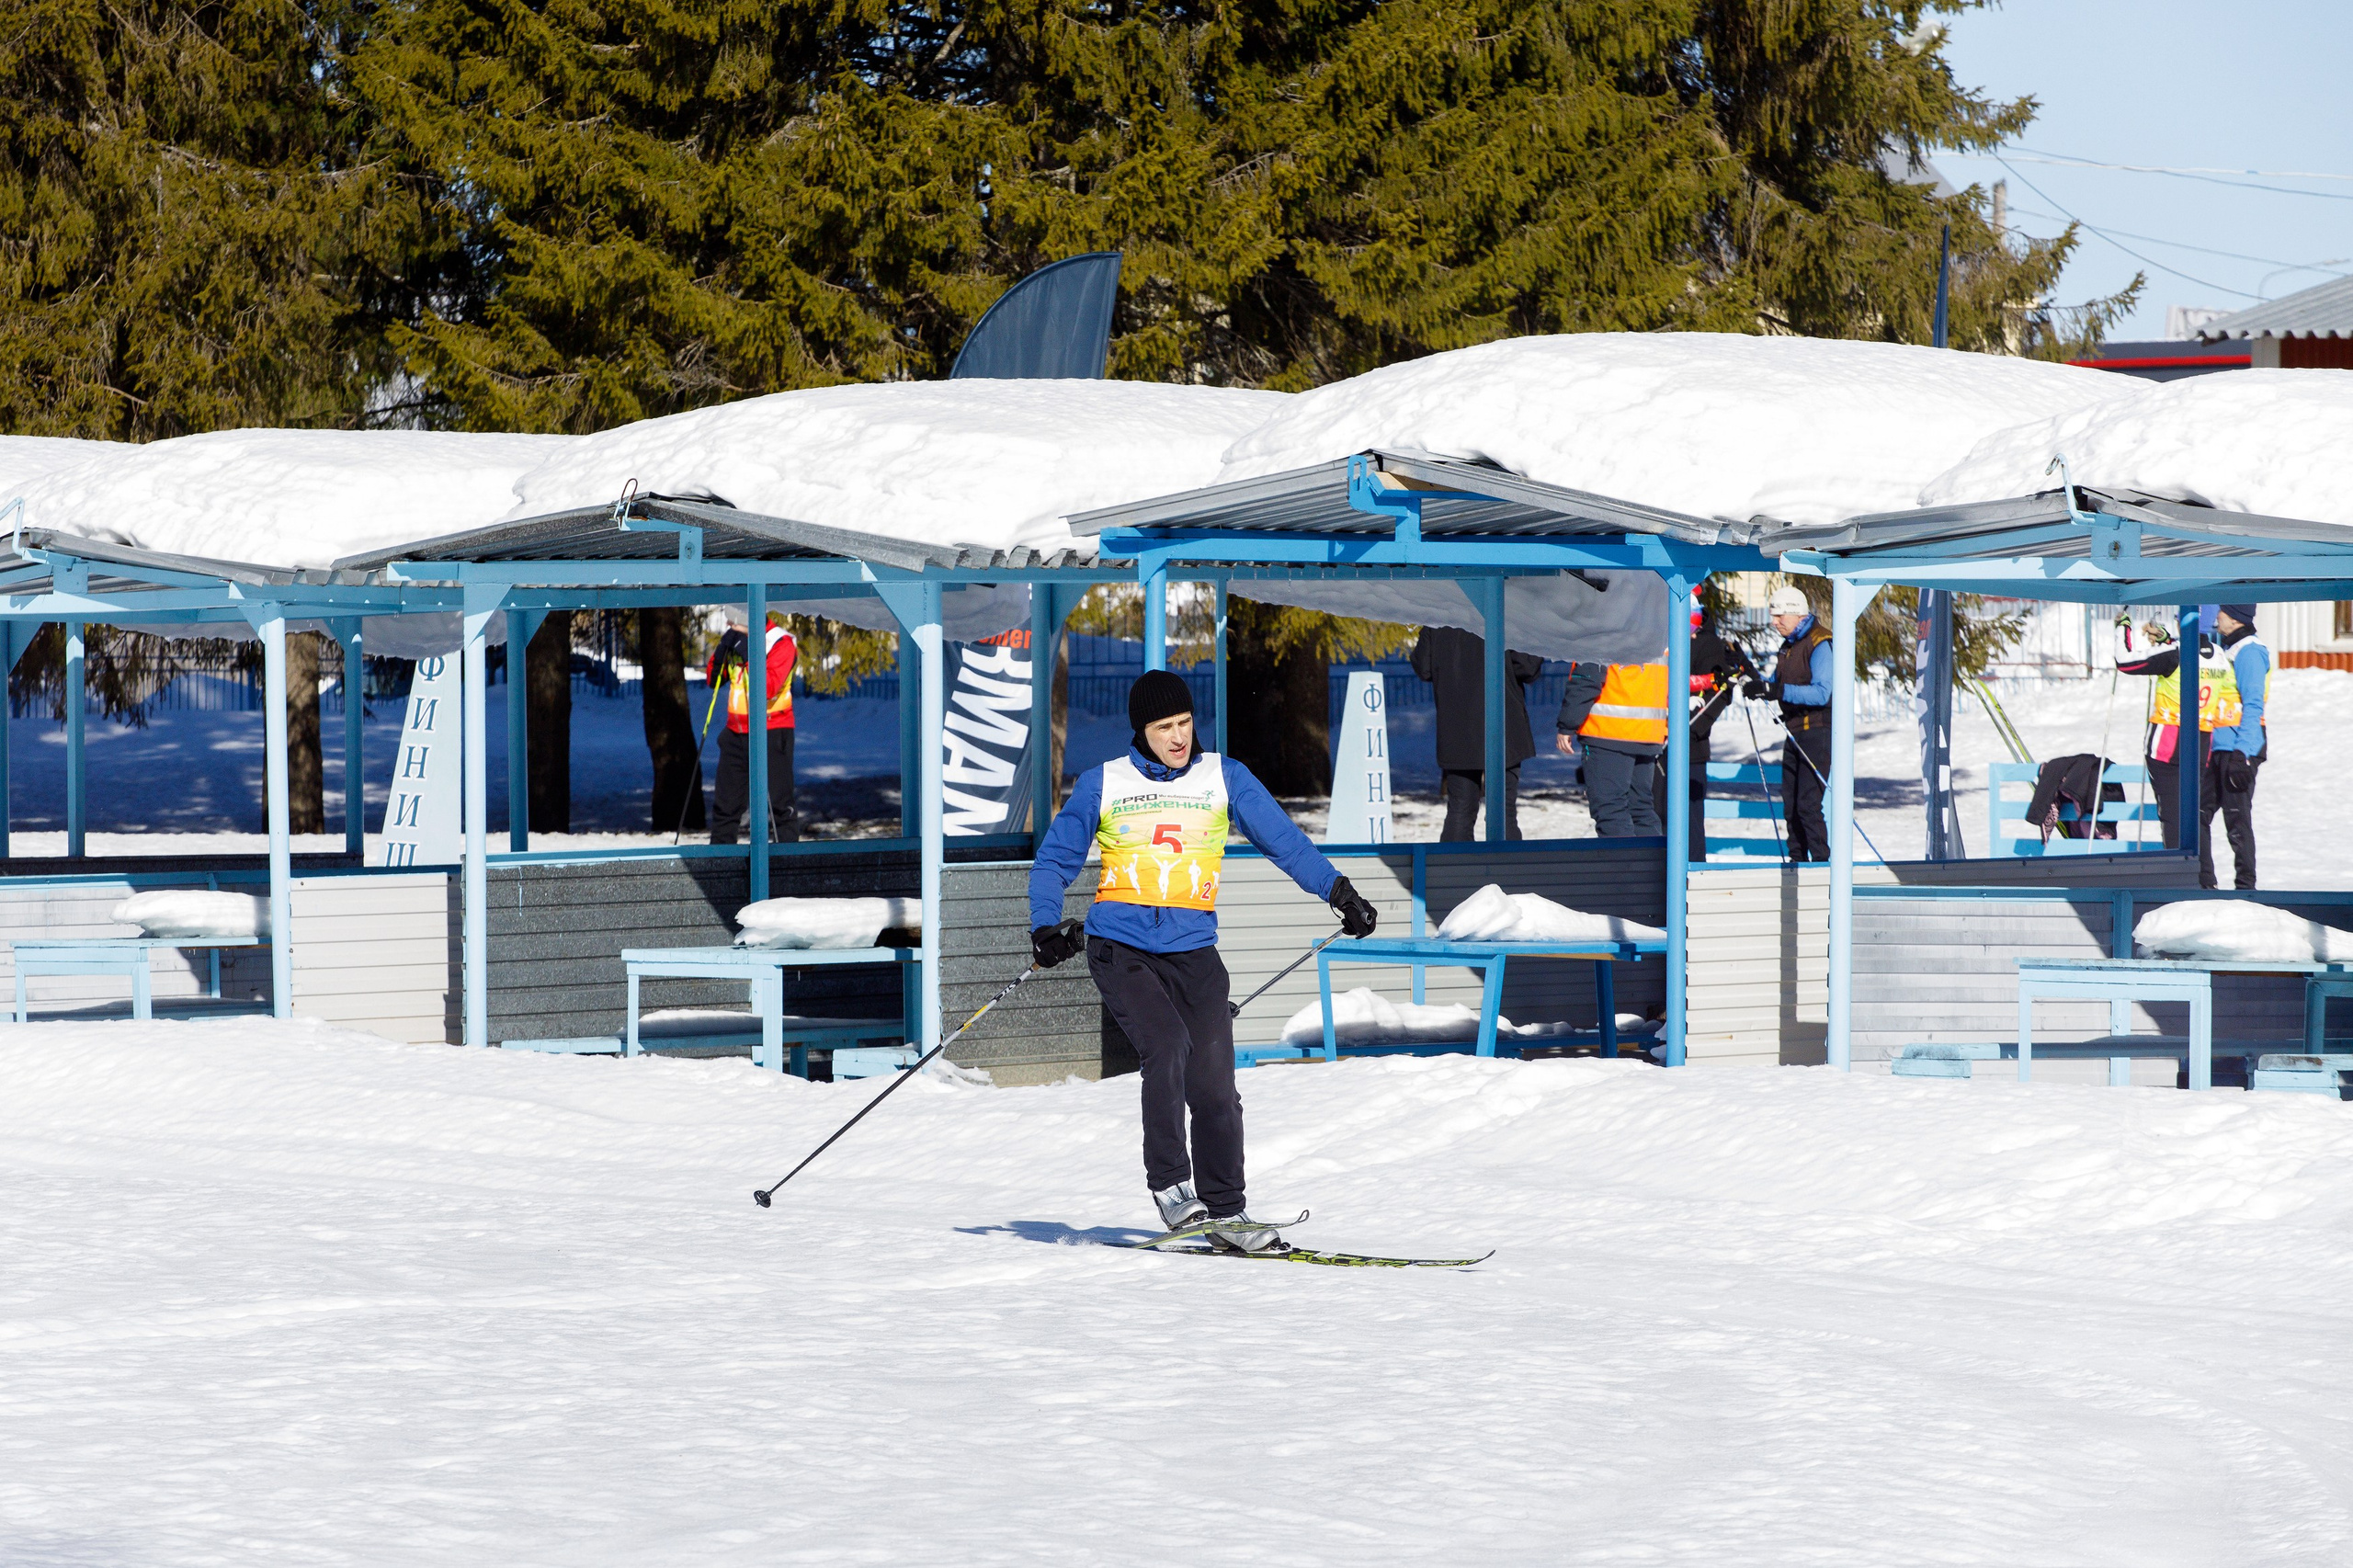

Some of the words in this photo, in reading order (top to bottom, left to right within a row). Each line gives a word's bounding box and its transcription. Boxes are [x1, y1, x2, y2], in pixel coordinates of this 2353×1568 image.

[1111, 793, 1157, 807] #PRO
[1152, 824, 1183, 853] 5
[1201, 881, 1211, 900] 2
